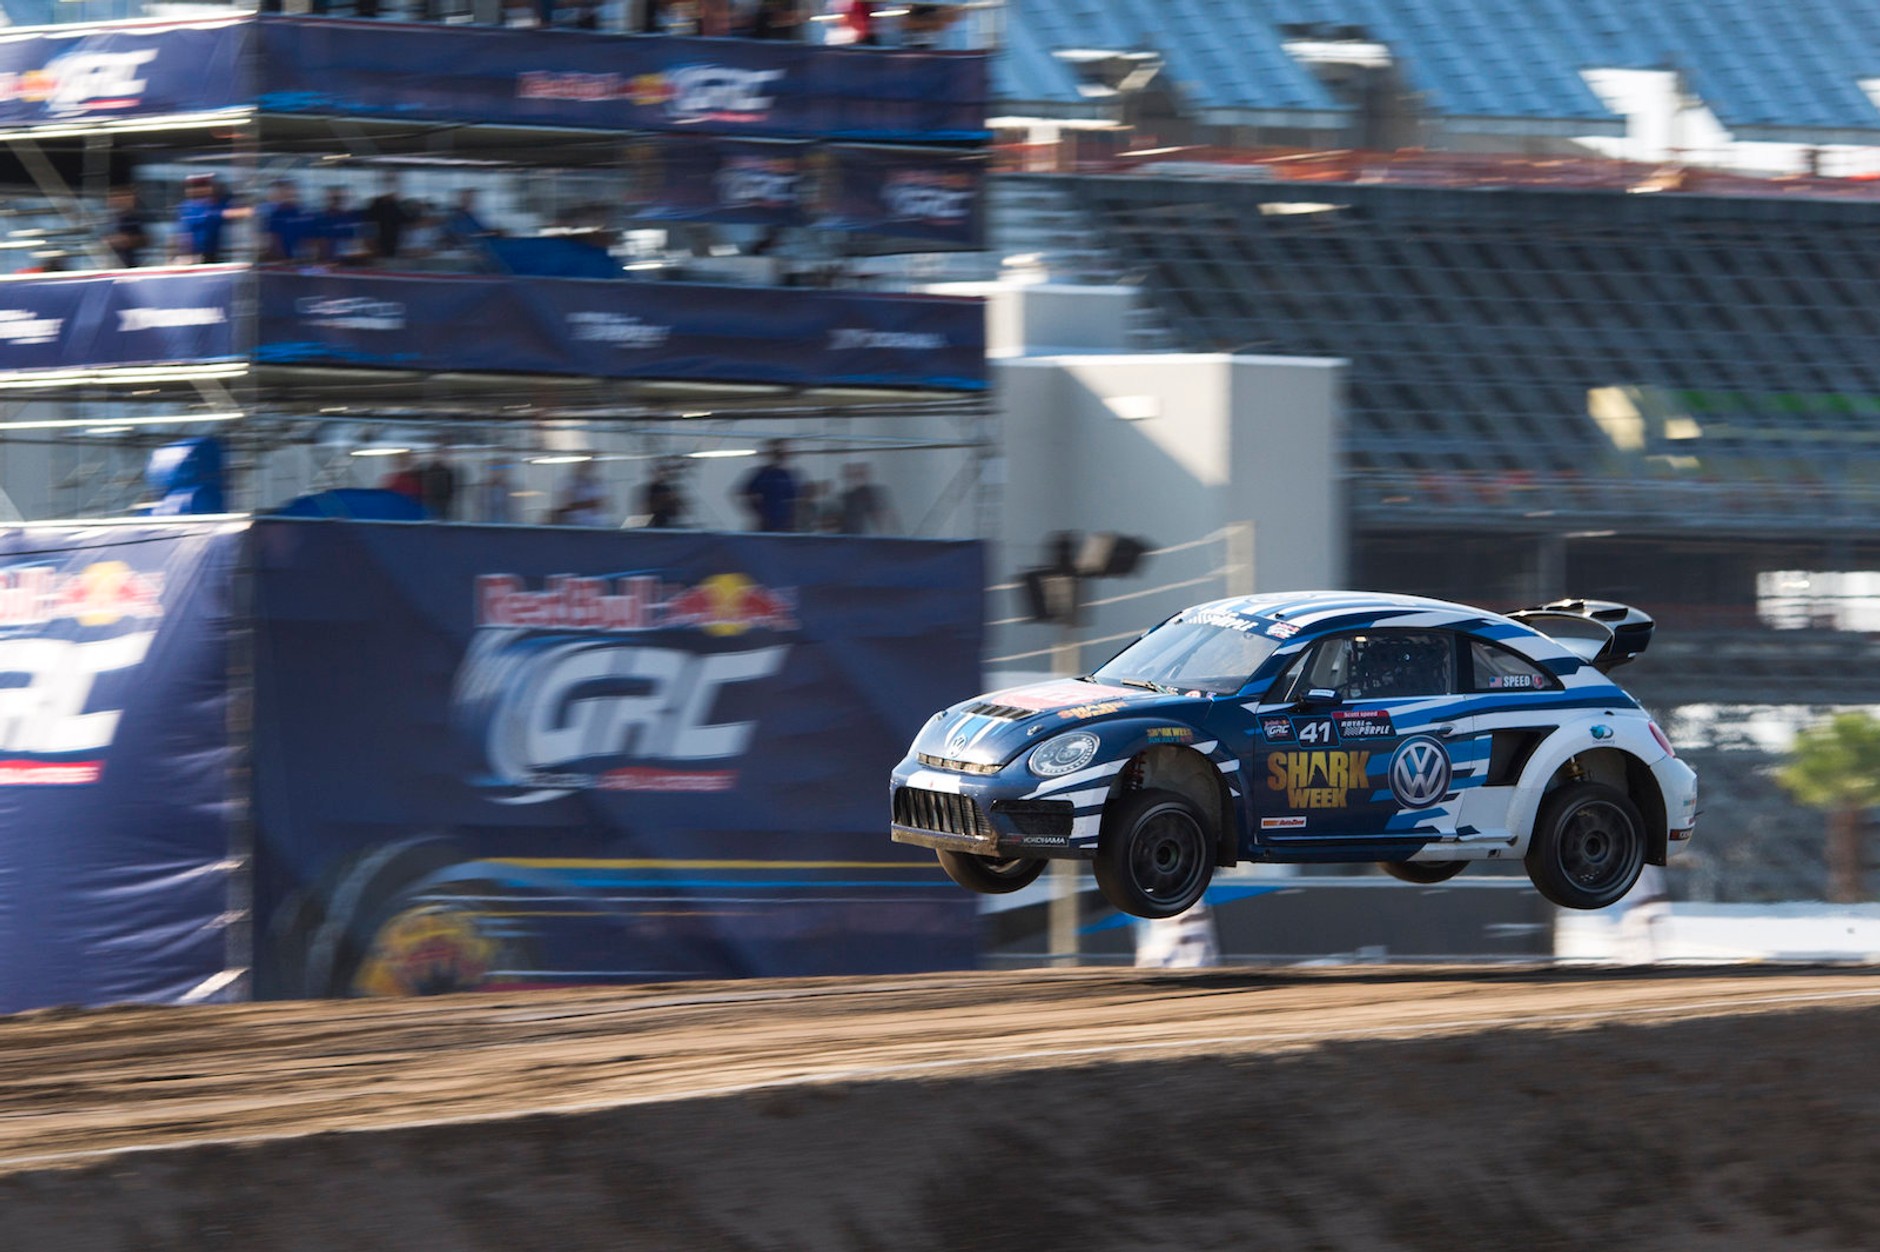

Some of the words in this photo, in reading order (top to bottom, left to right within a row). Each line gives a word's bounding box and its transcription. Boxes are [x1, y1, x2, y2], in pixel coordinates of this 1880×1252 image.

[1503, 675, 1531, 688] SPEED
[1299, 721, 1331, 743] 41
[1267, 751, 1370, 791] SHARK
[1288, 787, 1347, 809] WEEK
[1023, 836, 1066, 845] YOKOHAMA
